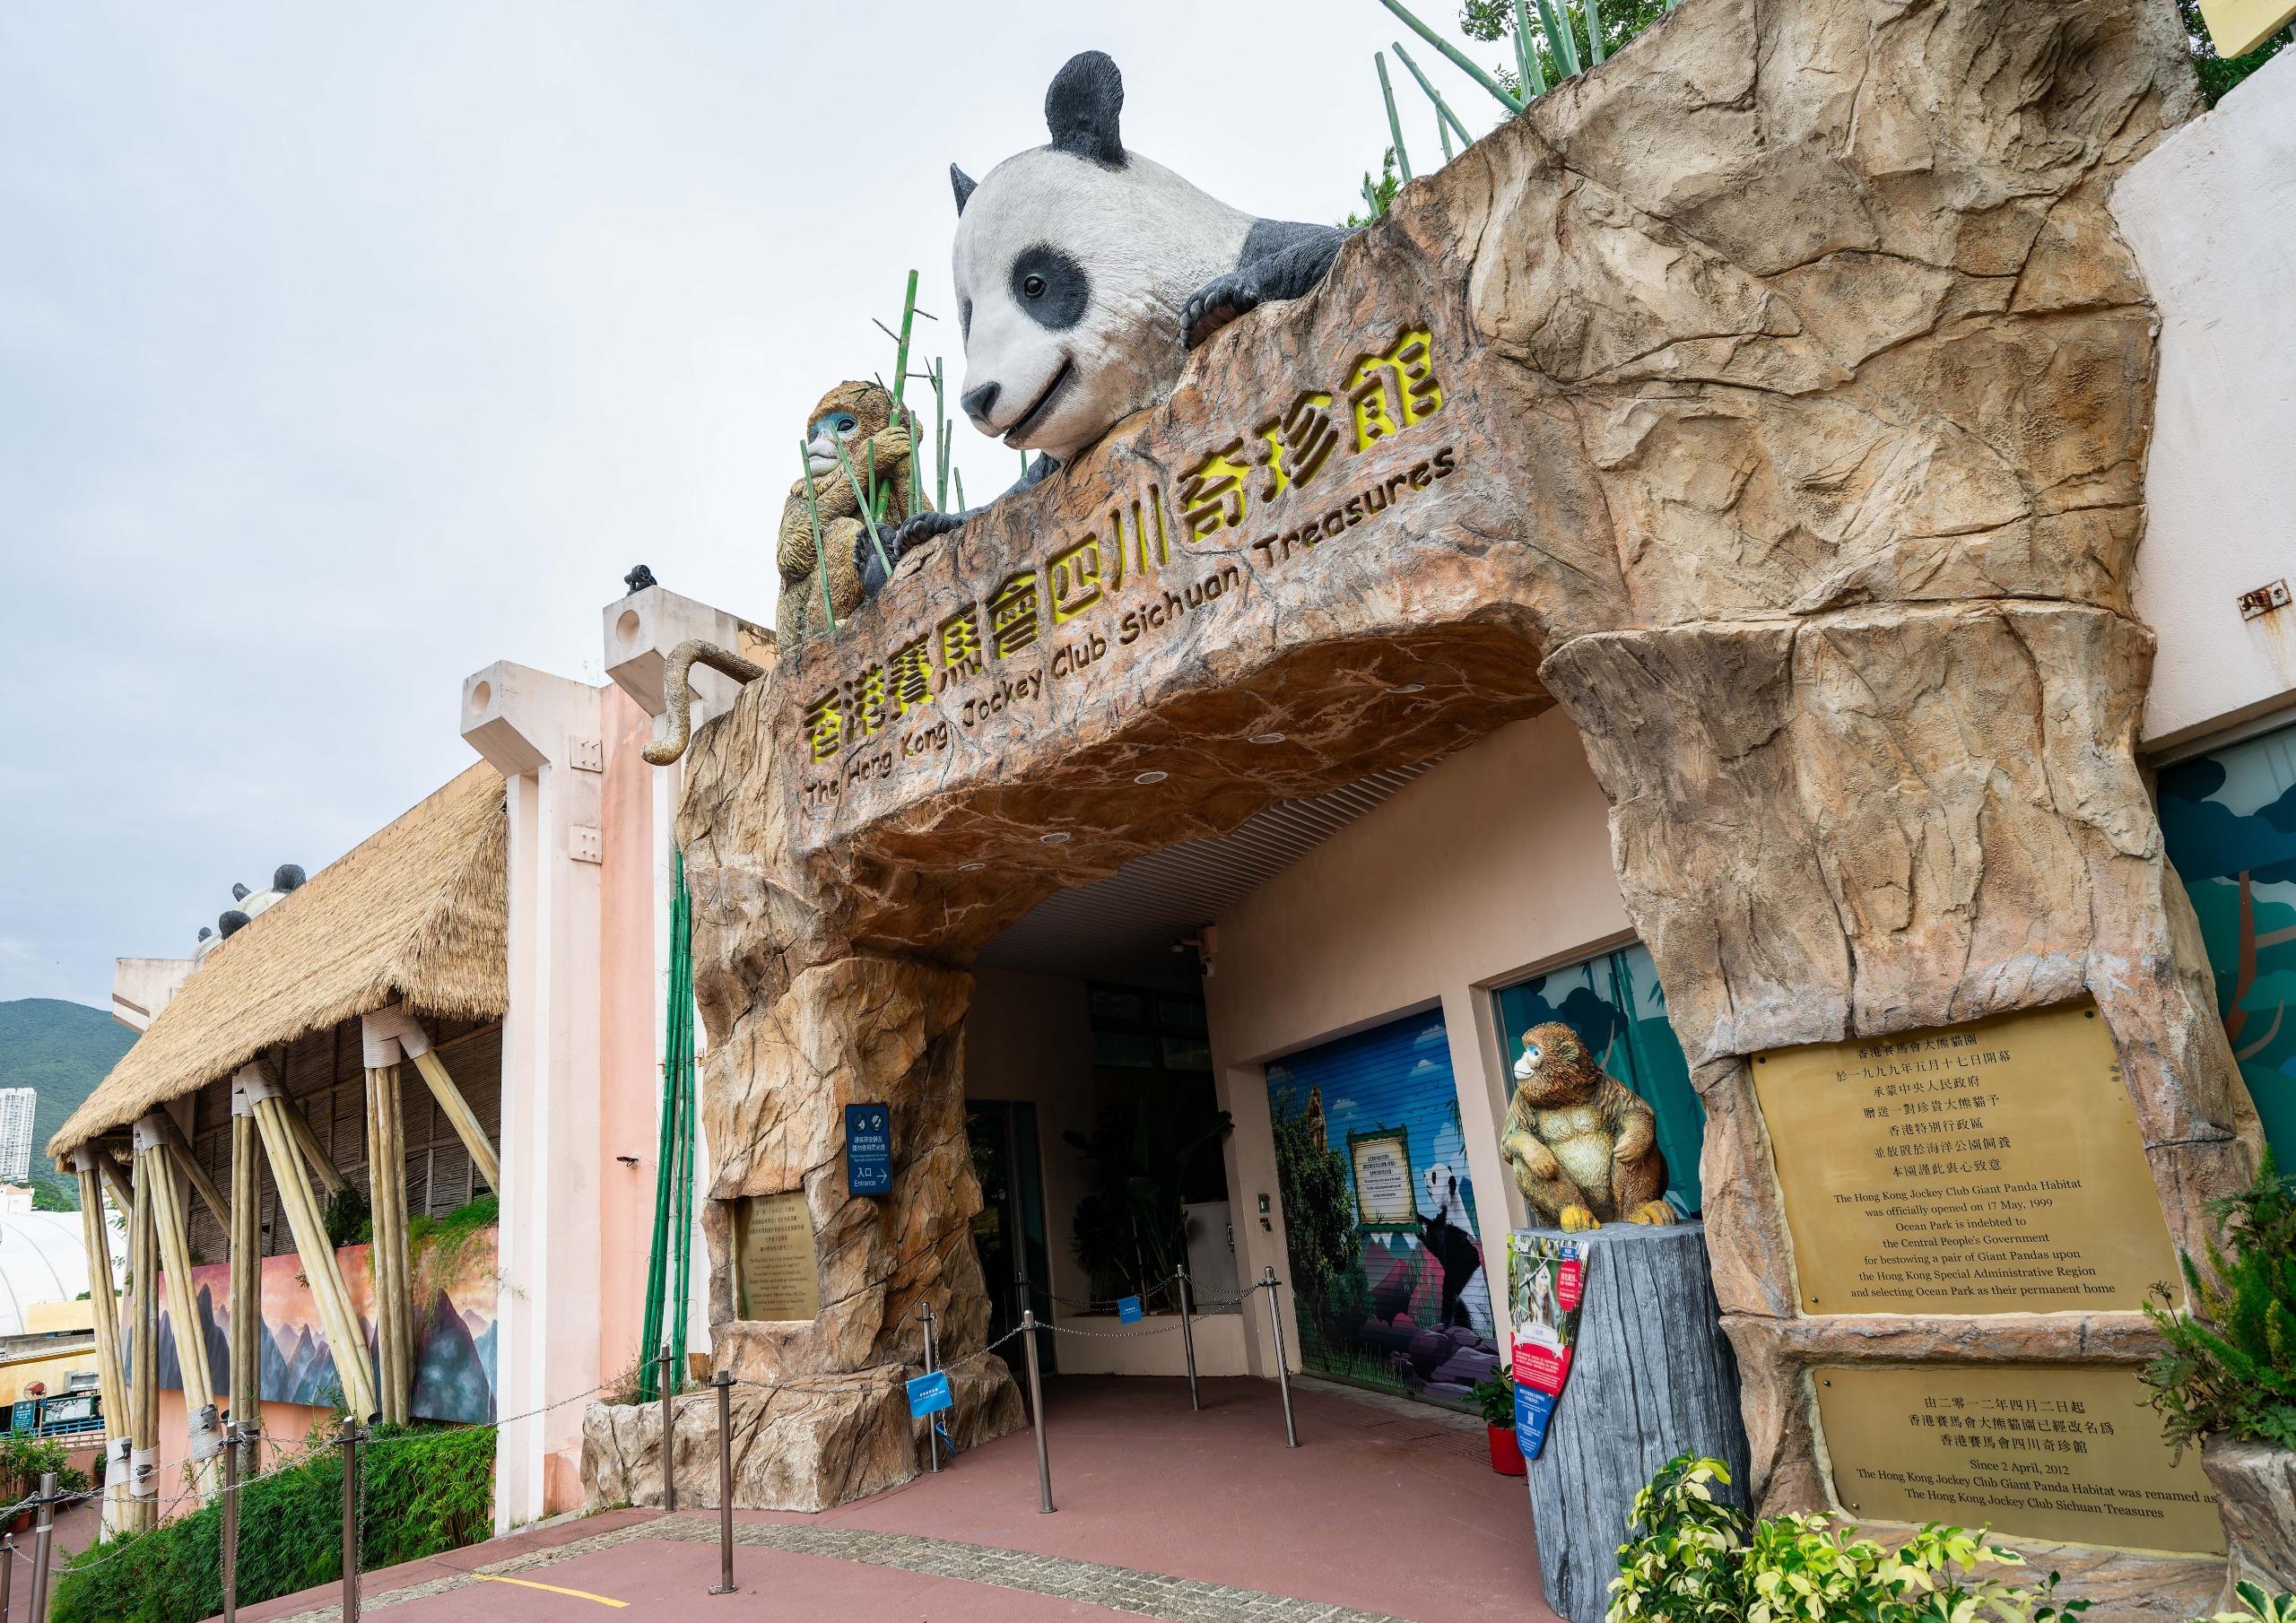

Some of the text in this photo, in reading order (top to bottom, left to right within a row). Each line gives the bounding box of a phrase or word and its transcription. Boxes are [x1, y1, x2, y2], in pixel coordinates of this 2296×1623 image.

[804, 326, 1442, 763] 香港賽馬會四川奇珍館
[806, 447, 1456, 807] The Hong Kong Jockey Club Sichuan Treasures
[1857, 1033, 1978, 1060] 香港賽馬會大熊貓園
[1836, 1050, 2012, 1082] 於一九九九年五月十七日開幕
[1873, 1075, 1979, 1098] 承蒙中央人民政府
[1863, 1094, 2000, 1119] 贈送一對珍貴大熊貓予
[1888, 1116, 1983, 1137] 香港特別行政區
[857, 1167, 872, 1178] 入口
[854, 1179, 876, 1187] Entrance
[1834, 1179, 2083, 1203] The Hong Kong Jockey Club Giant Panda Habitat
[1886, 1205, 1928, 1216] officially
[1931, 1202, 1968, 1215] opened
[1987, 1202, 1997, 1211] 17
[2000, 1200, 2026, 1211] May,
[2030, 1198, 2053, 1208] 1999
[1895, 1217, 2027, 1231] Ocean Park is indebted to
[1883, 1233, 2050, 1248] the Central People's Government
[1865, 1255, 1877, 1265] for
[1880, 1254, 1930, 1264] bestowing
[1942, 1253, 1962, 1264] pair
[1964, 1252, 1976, 1262] of
[1978, 1252, 2007, 1262] Giant
[2009, 1250, 2049, 1261] Pandas
[2052, 1250, 2081, 1261] upon
[1858, 1266, 2096, 1281] the Hong Kong Special Administrative Region
[1851, 1289, 1869, 1298] and
[1871, 1288, 1914, 1298] selecting
[1916, 1287, 1947, 1297] Ocean
[1950, 1287, 1975, 1296] Park
[1991, 1285, 2017, 1295] their
[2021, 1284, 2081, 1297] permanent
[2083, 1283, 2116, 1293] home
[1925, 1396, 2085, 1414] 由二零一二年四月二日起
[1940, 1434, 2088, 1454] 香港賽馬會四川奇珍館
[1970, 1459, 2070, 1475] Since 2 April, 2012
[1856, 1468, 2218, 1504] The Hong Kong Jockey Club Giant Panda Habitat was renamed as
[1904, 1488, 2164, 1518] The Hong Kong Jockey Club Sichuan Treasures
